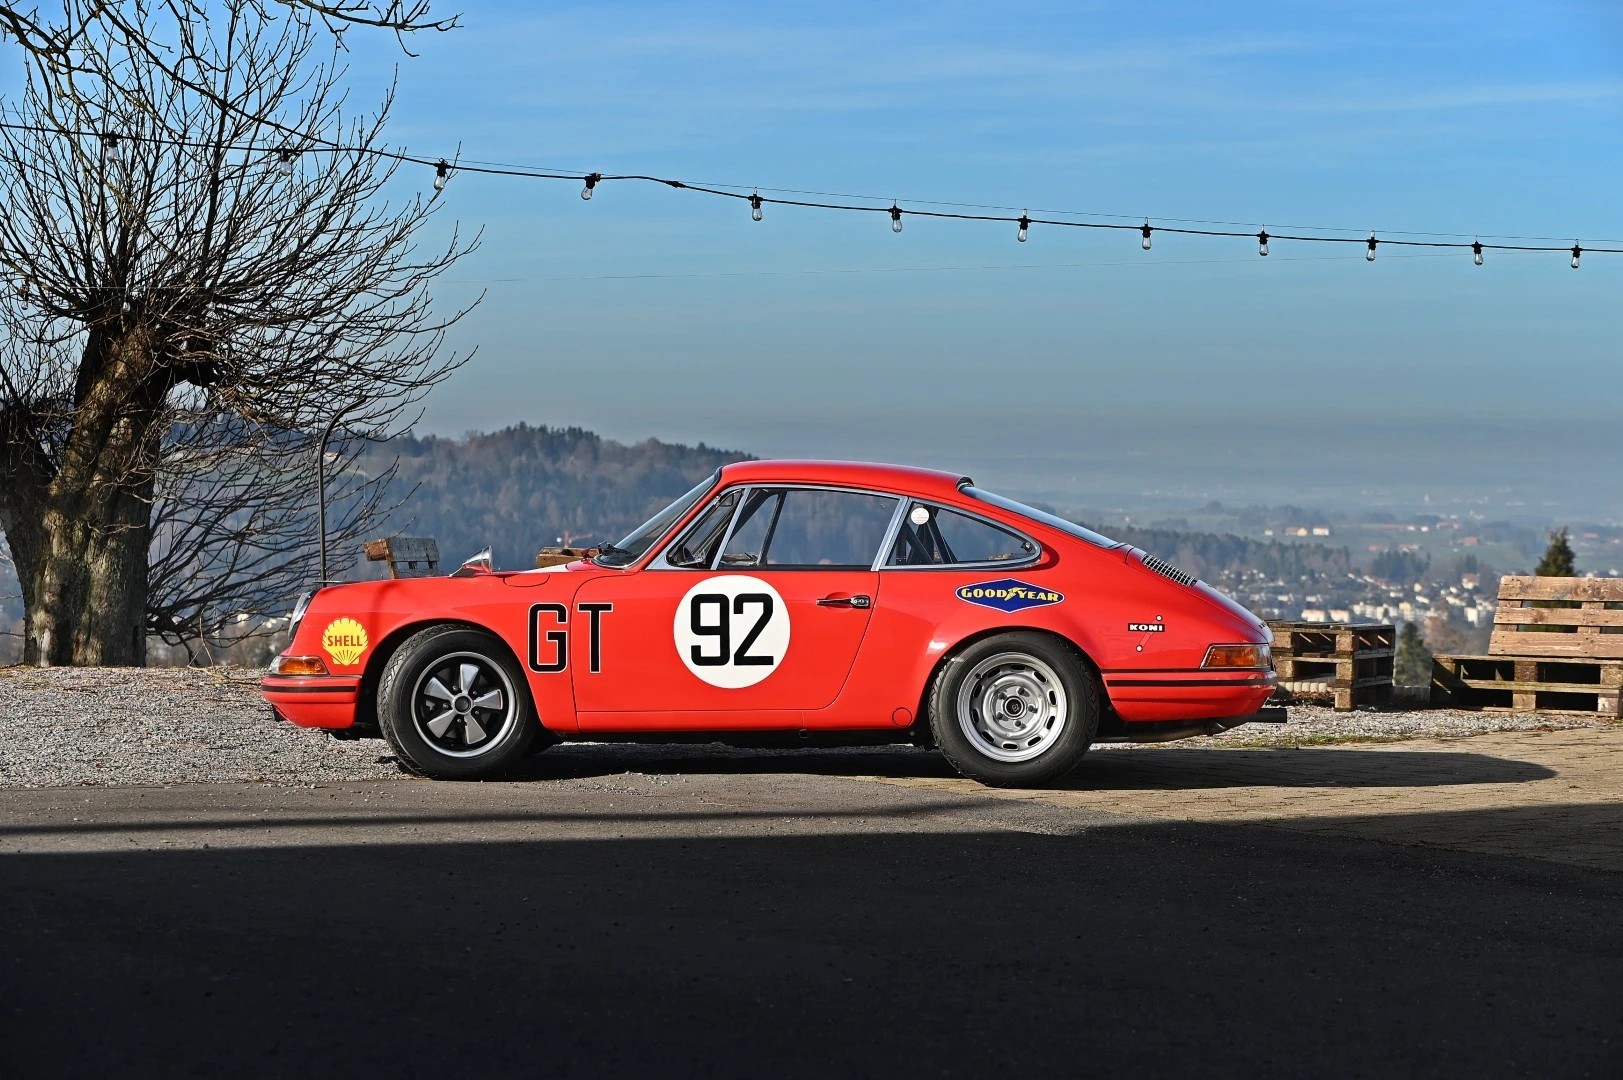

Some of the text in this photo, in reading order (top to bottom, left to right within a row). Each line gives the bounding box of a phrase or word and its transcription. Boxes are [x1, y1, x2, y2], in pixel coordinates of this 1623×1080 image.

[327, 635, 363, 647] SHELL
[528, 603, 613, 673] GT
[690, 593, 774, 666] 92
